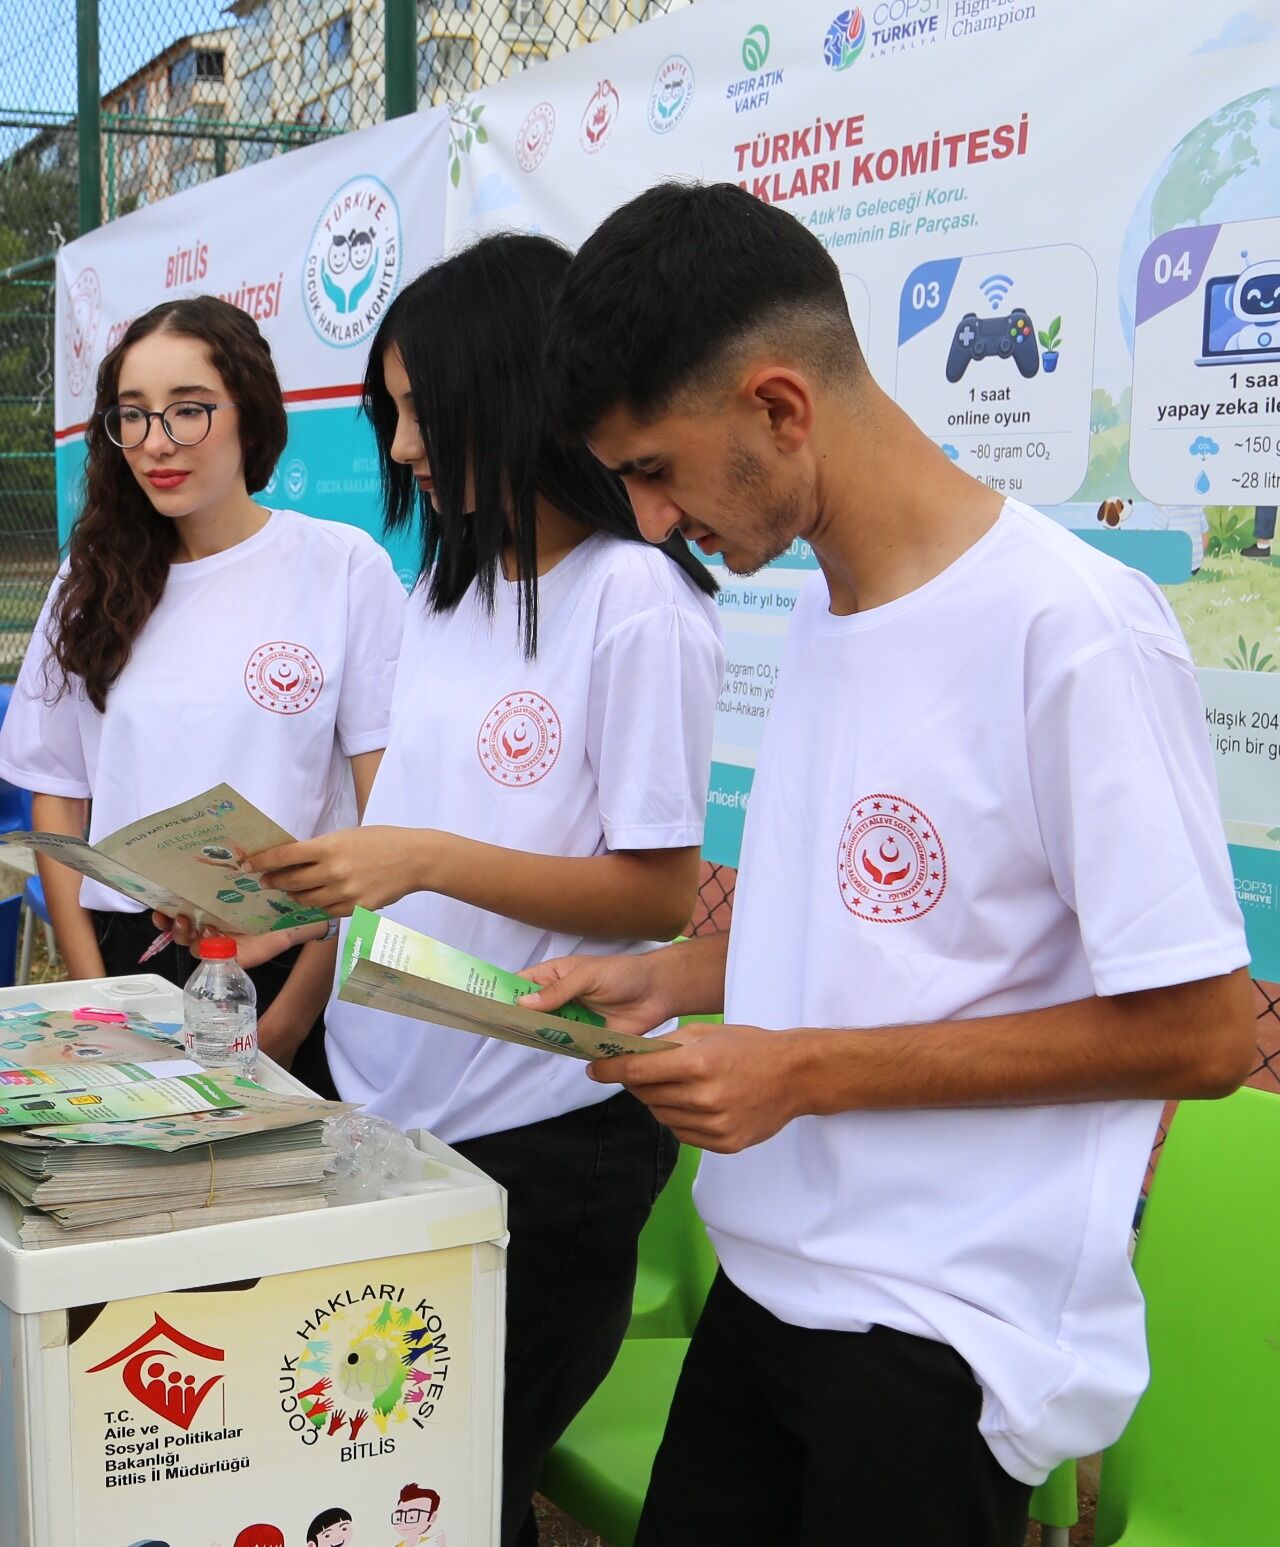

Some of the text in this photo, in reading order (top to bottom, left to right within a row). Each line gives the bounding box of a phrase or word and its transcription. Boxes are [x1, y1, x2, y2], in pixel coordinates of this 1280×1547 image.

[952, 5, 1037, 38] Champion
[870, 36, 937, 59] ANTALYA
[726, 67, 784, 99] SIFIR ATIK
[735, 91, 770, 115] VAKFI
[734, 114, 865, 172] TÜRKİYE
[737, 112, 1030, 204] AKLARI KOMİTESİ
[324, 191, 387, 233] TÜRKİYE
[856, 191, 921, 219] Geleceği
[925, 187, 969, 207] Koru.
[888, 219, 912, 240] Bir
[915, 213, 980, 236] Parçası.
[165, 240, 209, 288] BİTLİS
[1154, 250, 1193, 284] 04
[912, 280, 941, 311] 03
[318, 312, 365, 341] HAKLARI
[1230, 372, 1280, 389] 1 saa
[968, 386, 1012, 402] 1 saat
[947, 409, 1031, 428] online oyun
[1157, 402, 1211, 422] yapay
[1215, 398, 1259, 416] zeka
[970, 443, 992, 460] ~80
[993, 445, 1023, 463] gram
[1234, 435, 1272, 453] ~150
[1008, 477, 1023, 491] su
[1231, 471, 1260, 489] ~28
[743, 591, 758, 606] bir
[760, 593, 773, 610] yıl
[776, 595, 797, 612] boy
[725, 660, 755, 679] ilogram
[733, 682, 748, 696] 970
[749, 683, 763, 698] km
[1206, 706, 1279, 731] klaşık 204
[1216, 733, 1240, 755] için
[1246, 736, 1265, 756] bir
[296, 1283, 405, 1340] HAKLARI
[279, 1354, 319, 1446] ÇOCUK
[104, 1409, 134, 1424] T.C.
[104, 1424, 159, 1440] Aile ve
[105, 1428, 244, 1456] Sosyal Politikalar
[340, 1437, 396, 1462] BİTLİS
[105, 1452, 180, 1472] Bakanlığı
[105, 1456, 250, 1488] Bitlis İl Müdürlüğü
